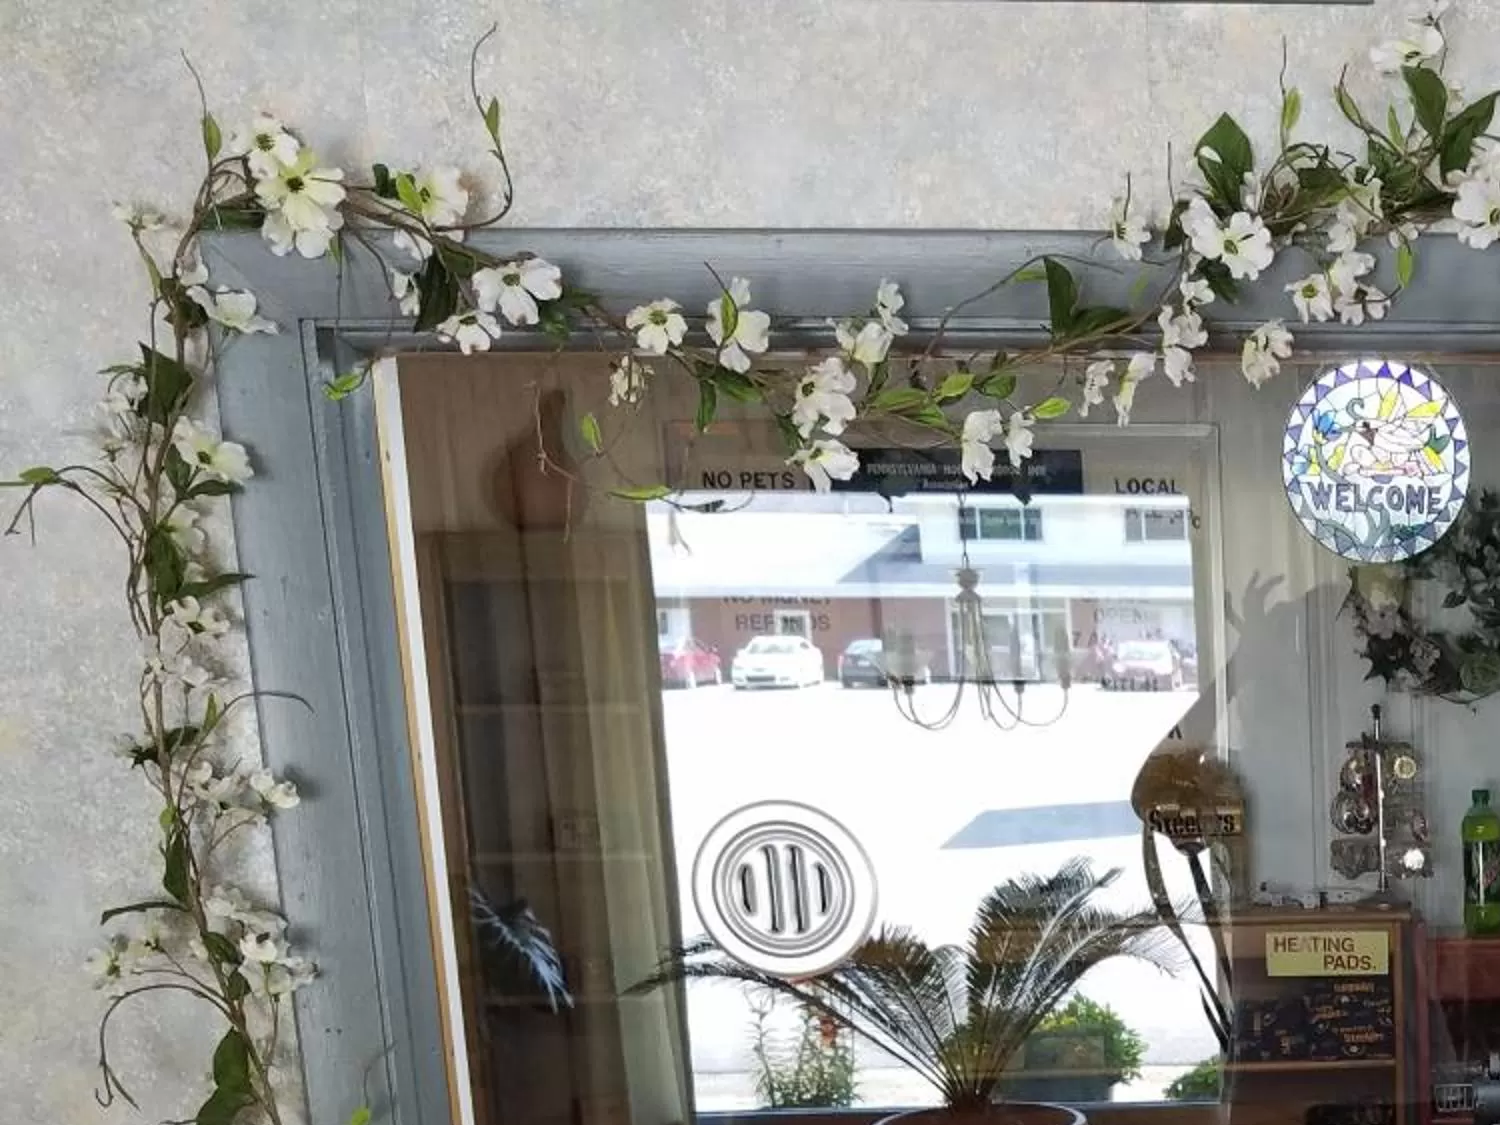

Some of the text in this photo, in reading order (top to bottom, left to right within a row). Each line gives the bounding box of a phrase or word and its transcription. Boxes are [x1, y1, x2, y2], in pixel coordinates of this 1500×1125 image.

[702, 470, 795, 489] NO PETS
[1115, 478, 1183, 494] LOCAL
[1308, 482, 1443, 514] WELCOME
